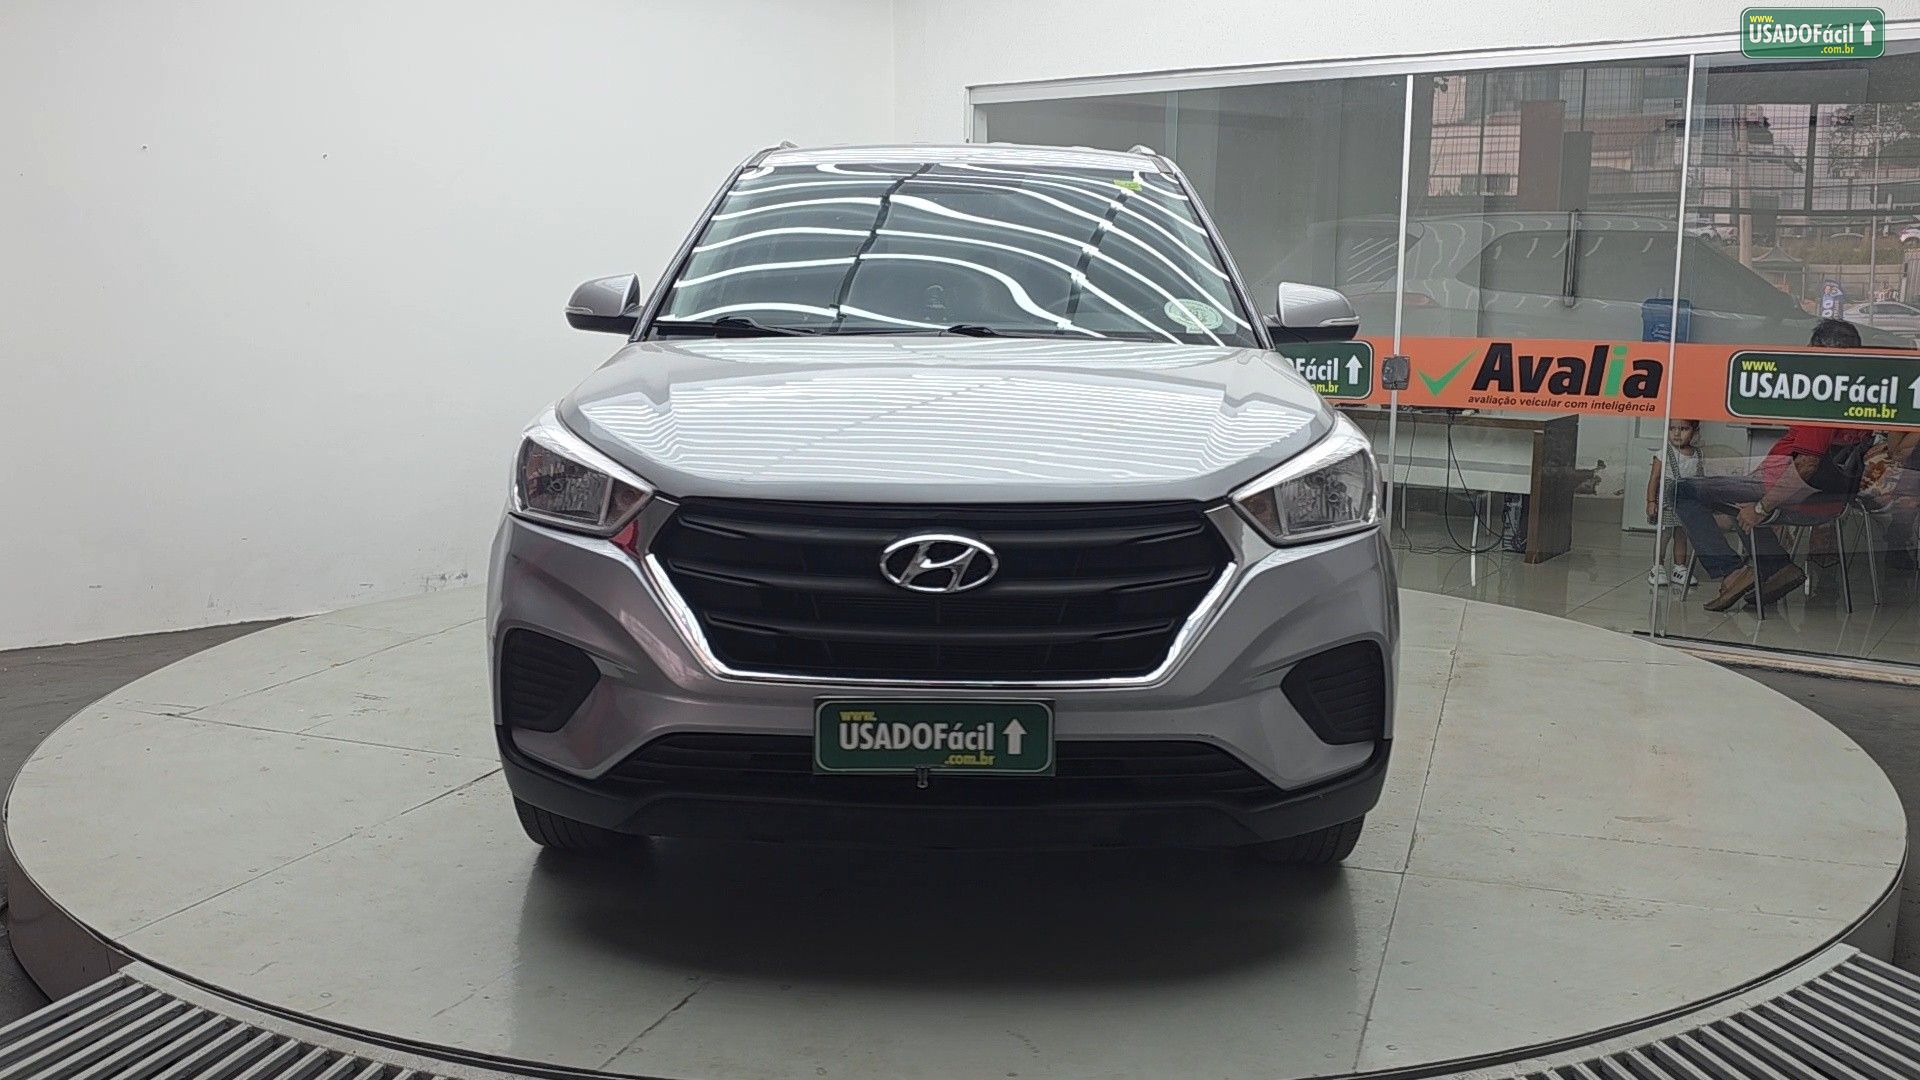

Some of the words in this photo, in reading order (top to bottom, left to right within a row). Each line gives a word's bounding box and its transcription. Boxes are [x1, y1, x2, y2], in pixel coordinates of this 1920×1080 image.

[1471, 343, 1664, 398] Avalia
[1742, 361, 1777, 371] www.
[1739, 372, 1898, 404] USADOFácil
[1468, 395, 1516, 406] avaliação
[1519, 397, 1561, 408] veicular
[1564, 401, 1588, 409] com
[1590, 401, 1656, 413] inteligência
[1844, 404, 1897, 418] .com.br
[840, 711, 877, 722] www.
[839, 722, 995, 751] USADOFácil
[945, 751, 995, 765] .com.br
